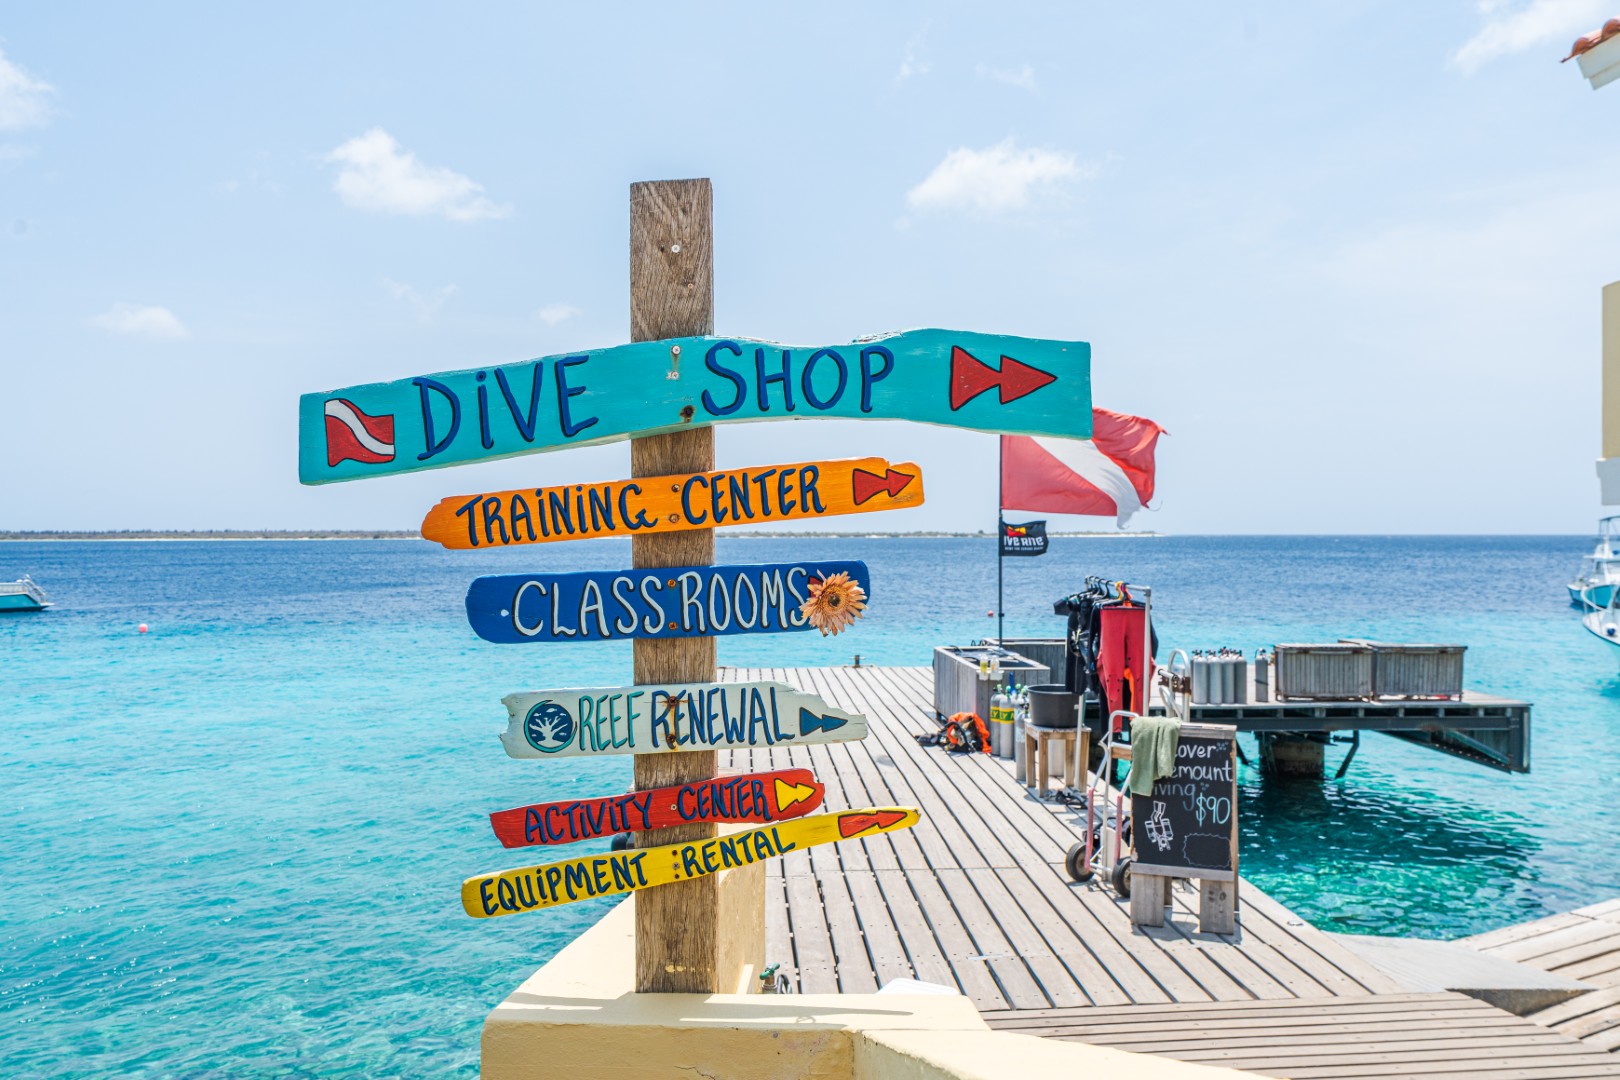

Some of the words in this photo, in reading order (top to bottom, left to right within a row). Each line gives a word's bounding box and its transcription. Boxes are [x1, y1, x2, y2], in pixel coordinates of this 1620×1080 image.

[701, 340, 895, 416] SHOP
[681, 464, 827, 525] CENTER
[578, 691, 645, 752] REEF
[651, 686, 796, 749] RENEWAL
[1174, 743, 1217, 759] over
[676, 779, 773, 823] CENTER
[1196, 792, 1231, 827] $90
[681, 827, 797, 879] RENTAL
